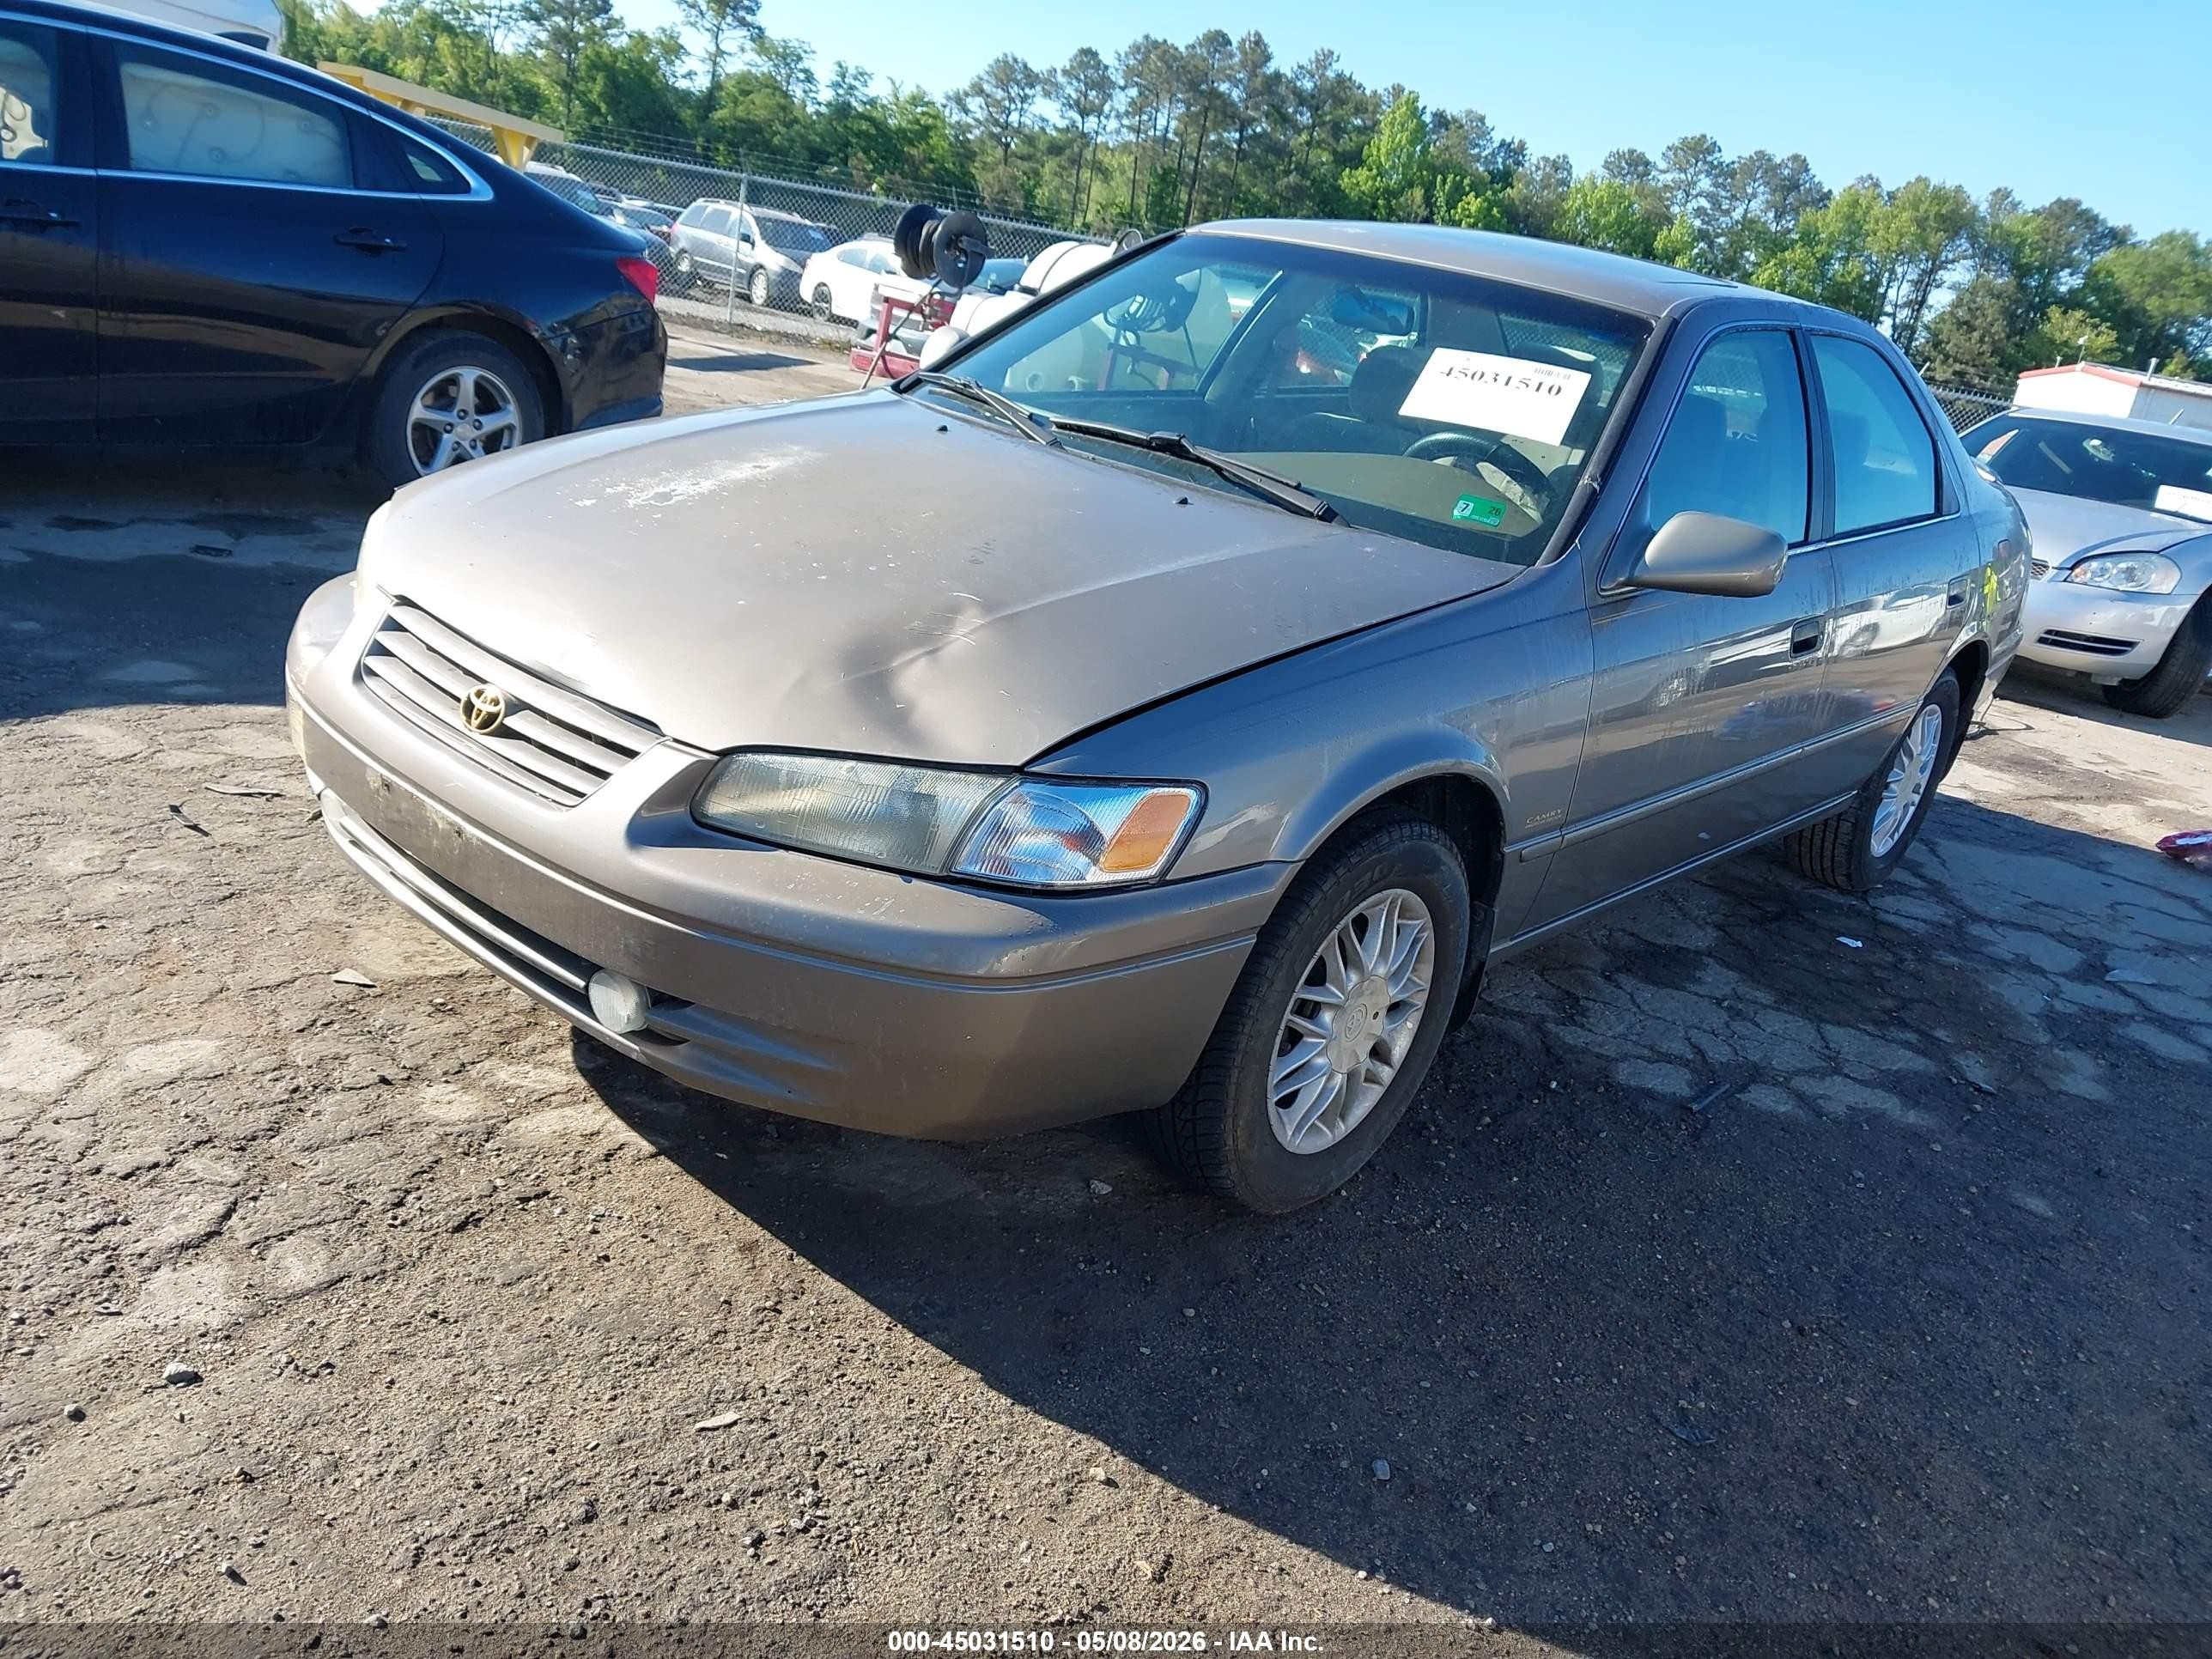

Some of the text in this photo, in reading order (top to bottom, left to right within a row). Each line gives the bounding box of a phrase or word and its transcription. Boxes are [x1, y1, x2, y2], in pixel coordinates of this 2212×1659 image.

[1440, 367, 1562, 396] 45031510
[1461, 502, 1470, 513] 7
[1526, 809, 1563, 824] CAMRY
